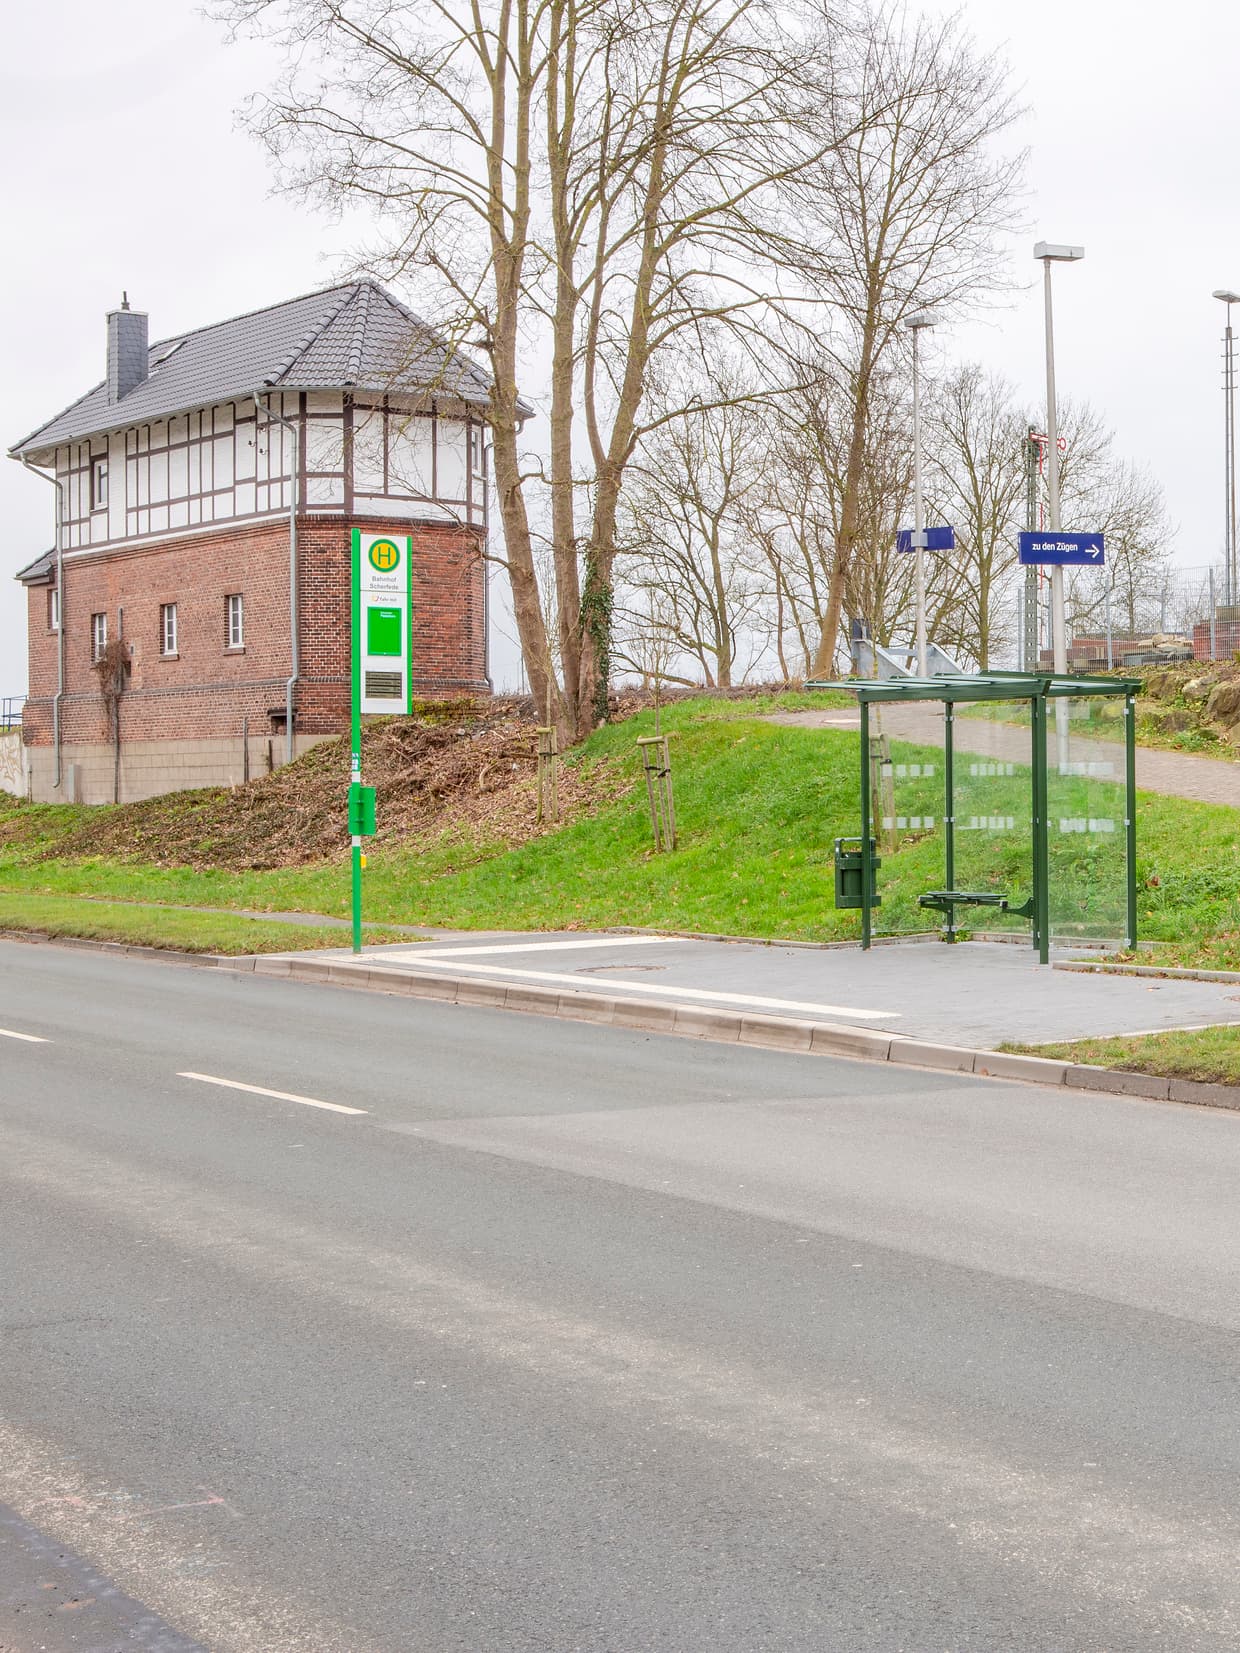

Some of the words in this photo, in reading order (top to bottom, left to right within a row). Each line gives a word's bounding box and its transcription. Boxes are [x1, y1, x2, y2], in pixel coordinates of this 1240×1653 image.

[1032, 543, 1041, 551] zu
[1042, 542, 1055, 551] den
[1056, 542, 1078, 552] Zügen
[378, 546, 391, 565] H
